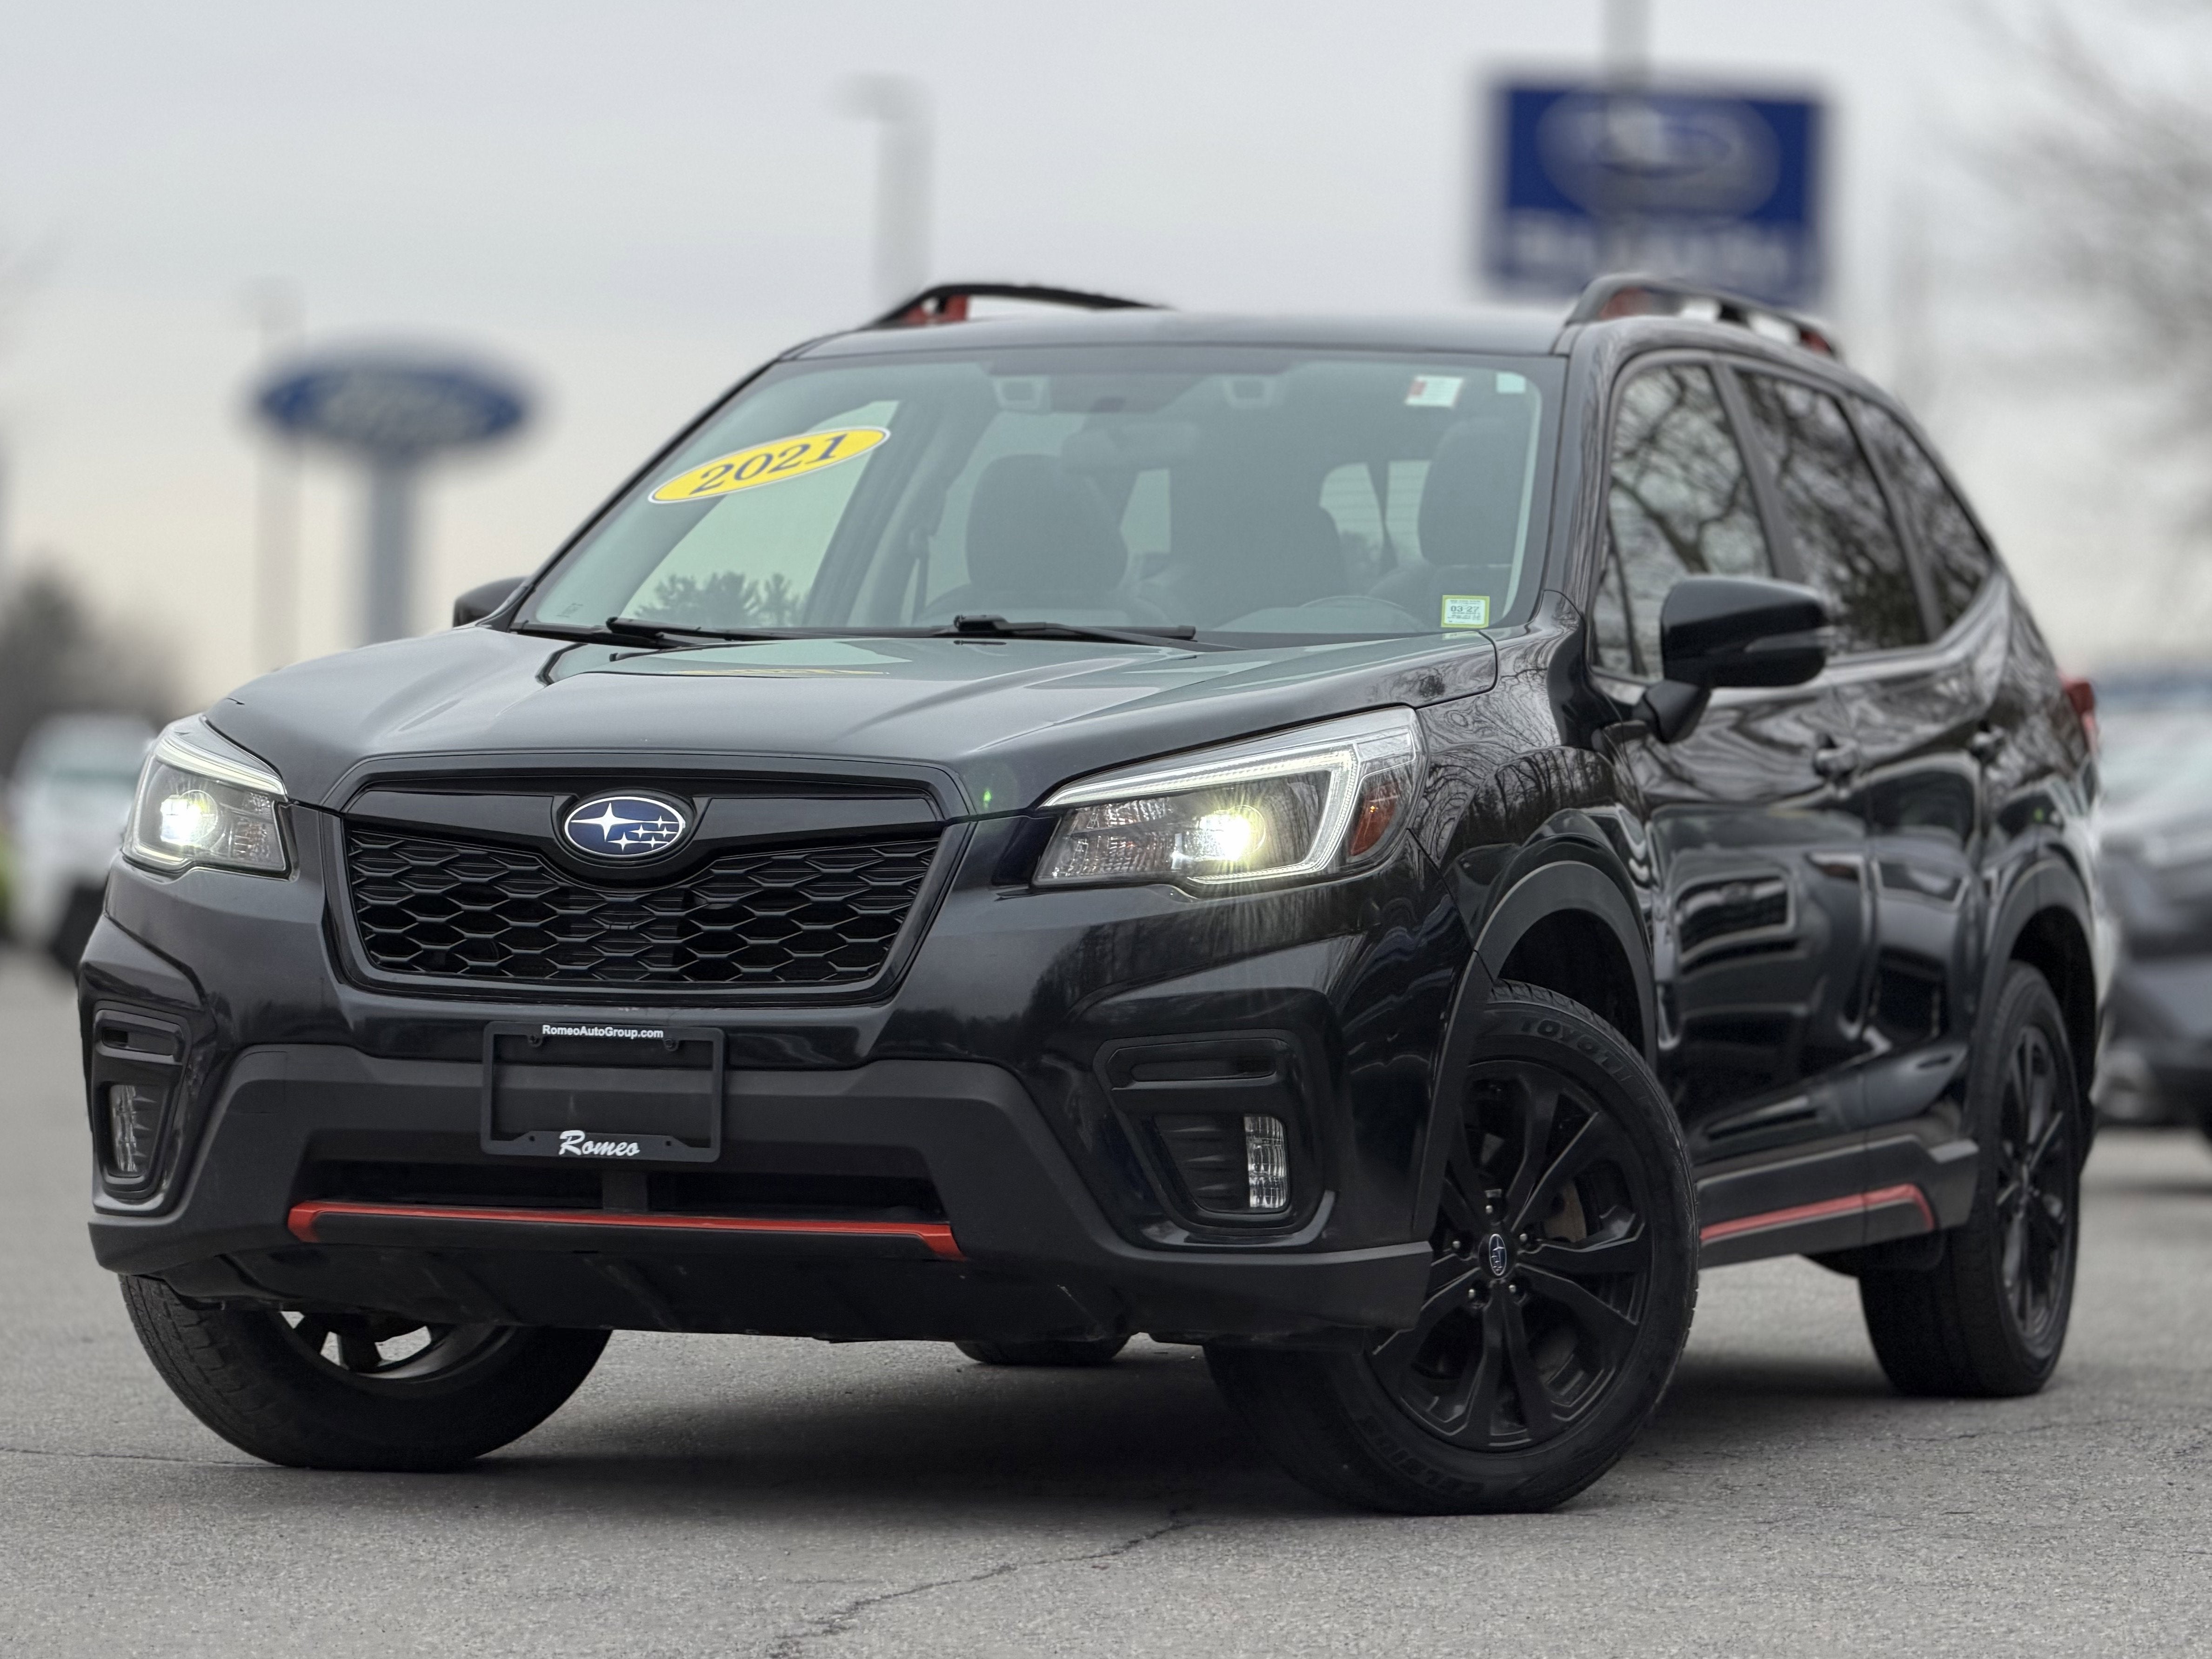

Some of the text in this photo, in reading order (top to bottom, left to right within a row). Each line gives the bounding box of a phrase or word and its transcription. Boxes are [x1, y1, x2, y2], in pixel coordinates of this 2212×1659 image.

[688, 434, 848, 495] 2021
[542, 1024, 664, 1039] RomeoAutoGroup.com
[559, 1130, 641, 1157] Romeo
